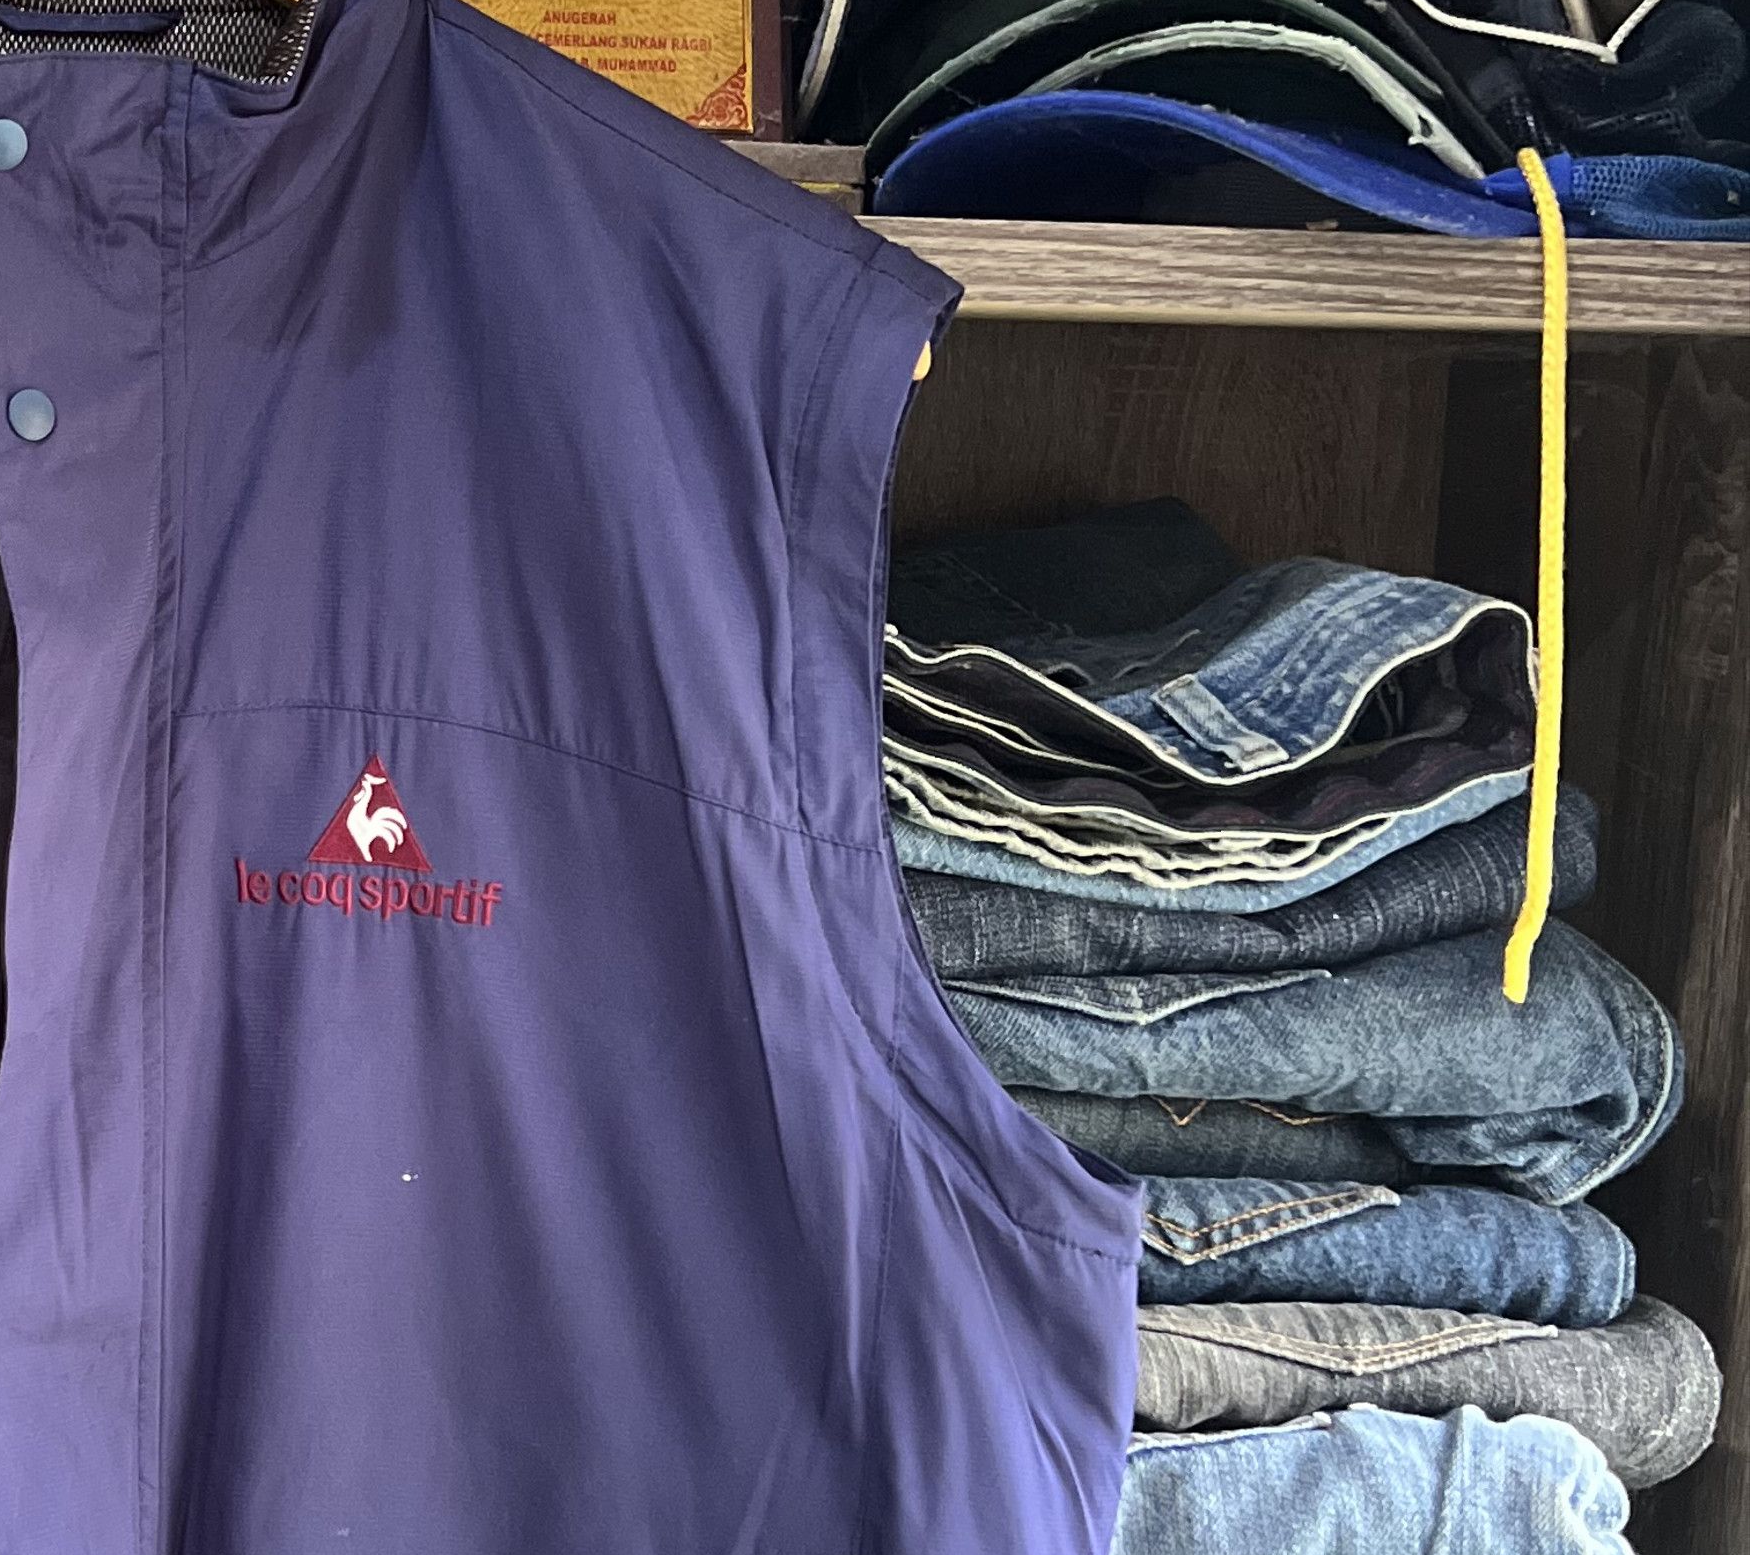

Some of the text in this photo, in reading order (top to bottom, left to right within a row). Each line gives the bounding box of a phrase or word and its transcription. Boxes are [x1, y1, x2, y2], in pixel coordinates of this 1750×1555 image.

[542, 10, 618, 26] ANUGERAH
[621, 36, 668, 52] SUKAN
[597, 57, 678, 74] MUHAMMAD
[234, 855, 504, 928] le coq sportif
